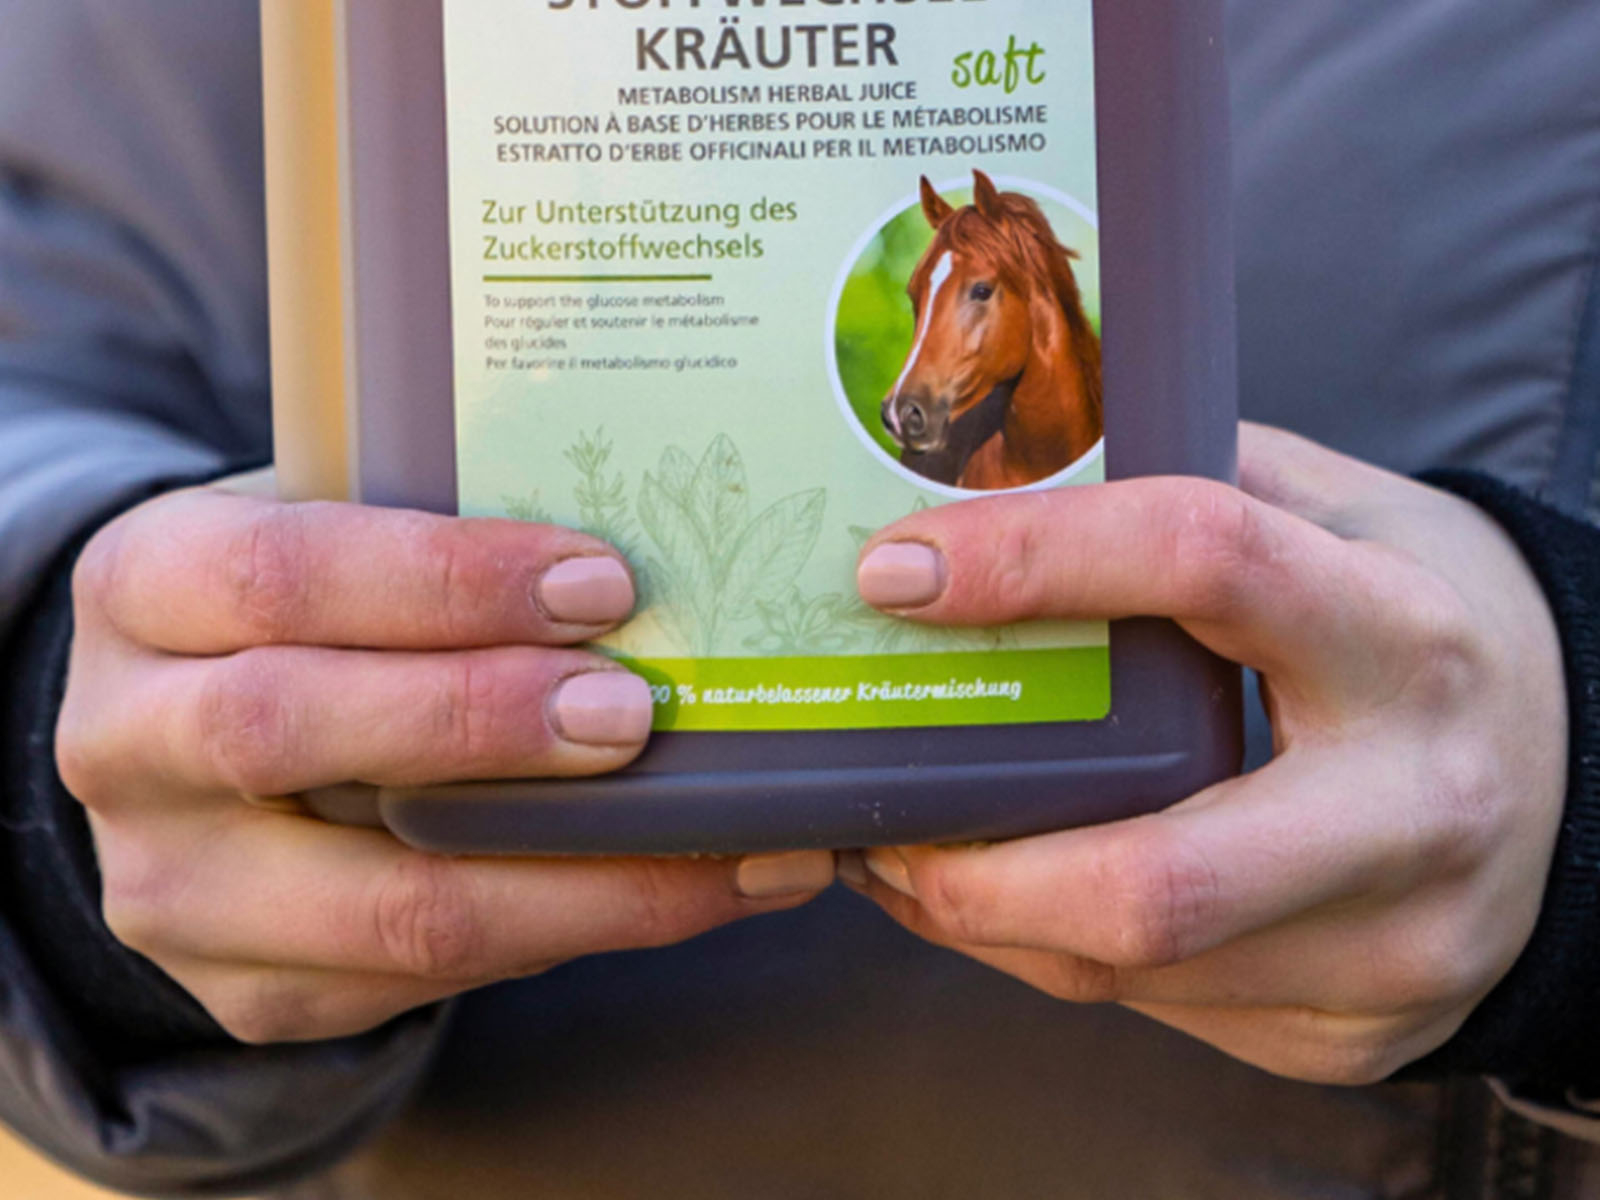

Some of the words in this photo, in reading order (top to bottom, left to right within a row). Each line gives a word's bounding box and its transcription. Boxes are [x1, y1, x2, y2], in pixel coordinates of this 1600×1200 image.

[636, 16, 899, 71] KRÄUTER
[951, 35, 1046, 93] saft
[618, 86, 761, 105] METABOLISM
[768, 83, 853, 103] HERBAL
[859, 81, 917, 101] JUICE
[494, 115, 599, 134] SOLUTION
[605, 111, 621, 133] À
[627, 115, 681, 133] BASE
[688, 113, 789, 132] D'HERBES
[796, 111, 856, 130] POUR
[863, 111, 886, 129] LE
[893, 105, 1048, 128] MÉTABOLISME
[497, 143, 602, 162] ESTRATTO
[609, 142, 683, 161] D'ERBE
[690, 141, 806, 161] OFFICINALI
[813, 139, 852, 158] PER
[859, 138, 877, 157] IL
[883, 133, 1047, 156] METABOLISMO
[482, 200, 527, 224] Zur
[536, 198, 741, 229] Unterstützung
[751, 196, 798, 221] des
[483, 233, 765, 260] Zuckerstoffwechsels
[485, 294, 500, 307] To
[504, 294, 556, 310] support
[560, 294, 582, 307] the
[586, 293, 639, 310] glucose
[643, 293, 725, 307] metabolism
[485, 316, 515, 328] Pour
[573, 317, 588, 328] et
[590, 315, 647, 328] soutenir
[668, 313, 760, 328] métabolisme
[485, 336, 507, 349] des
[486, 357, 507, 370] Per
[581, 354, 671, 369] metabolismo
[650, 684, 671, 704] 00
[676, 684, 697, 705] %
[702, 684, 853, 705] naturbelassener
[856, 678, 1023, 702] Kräutermischung
